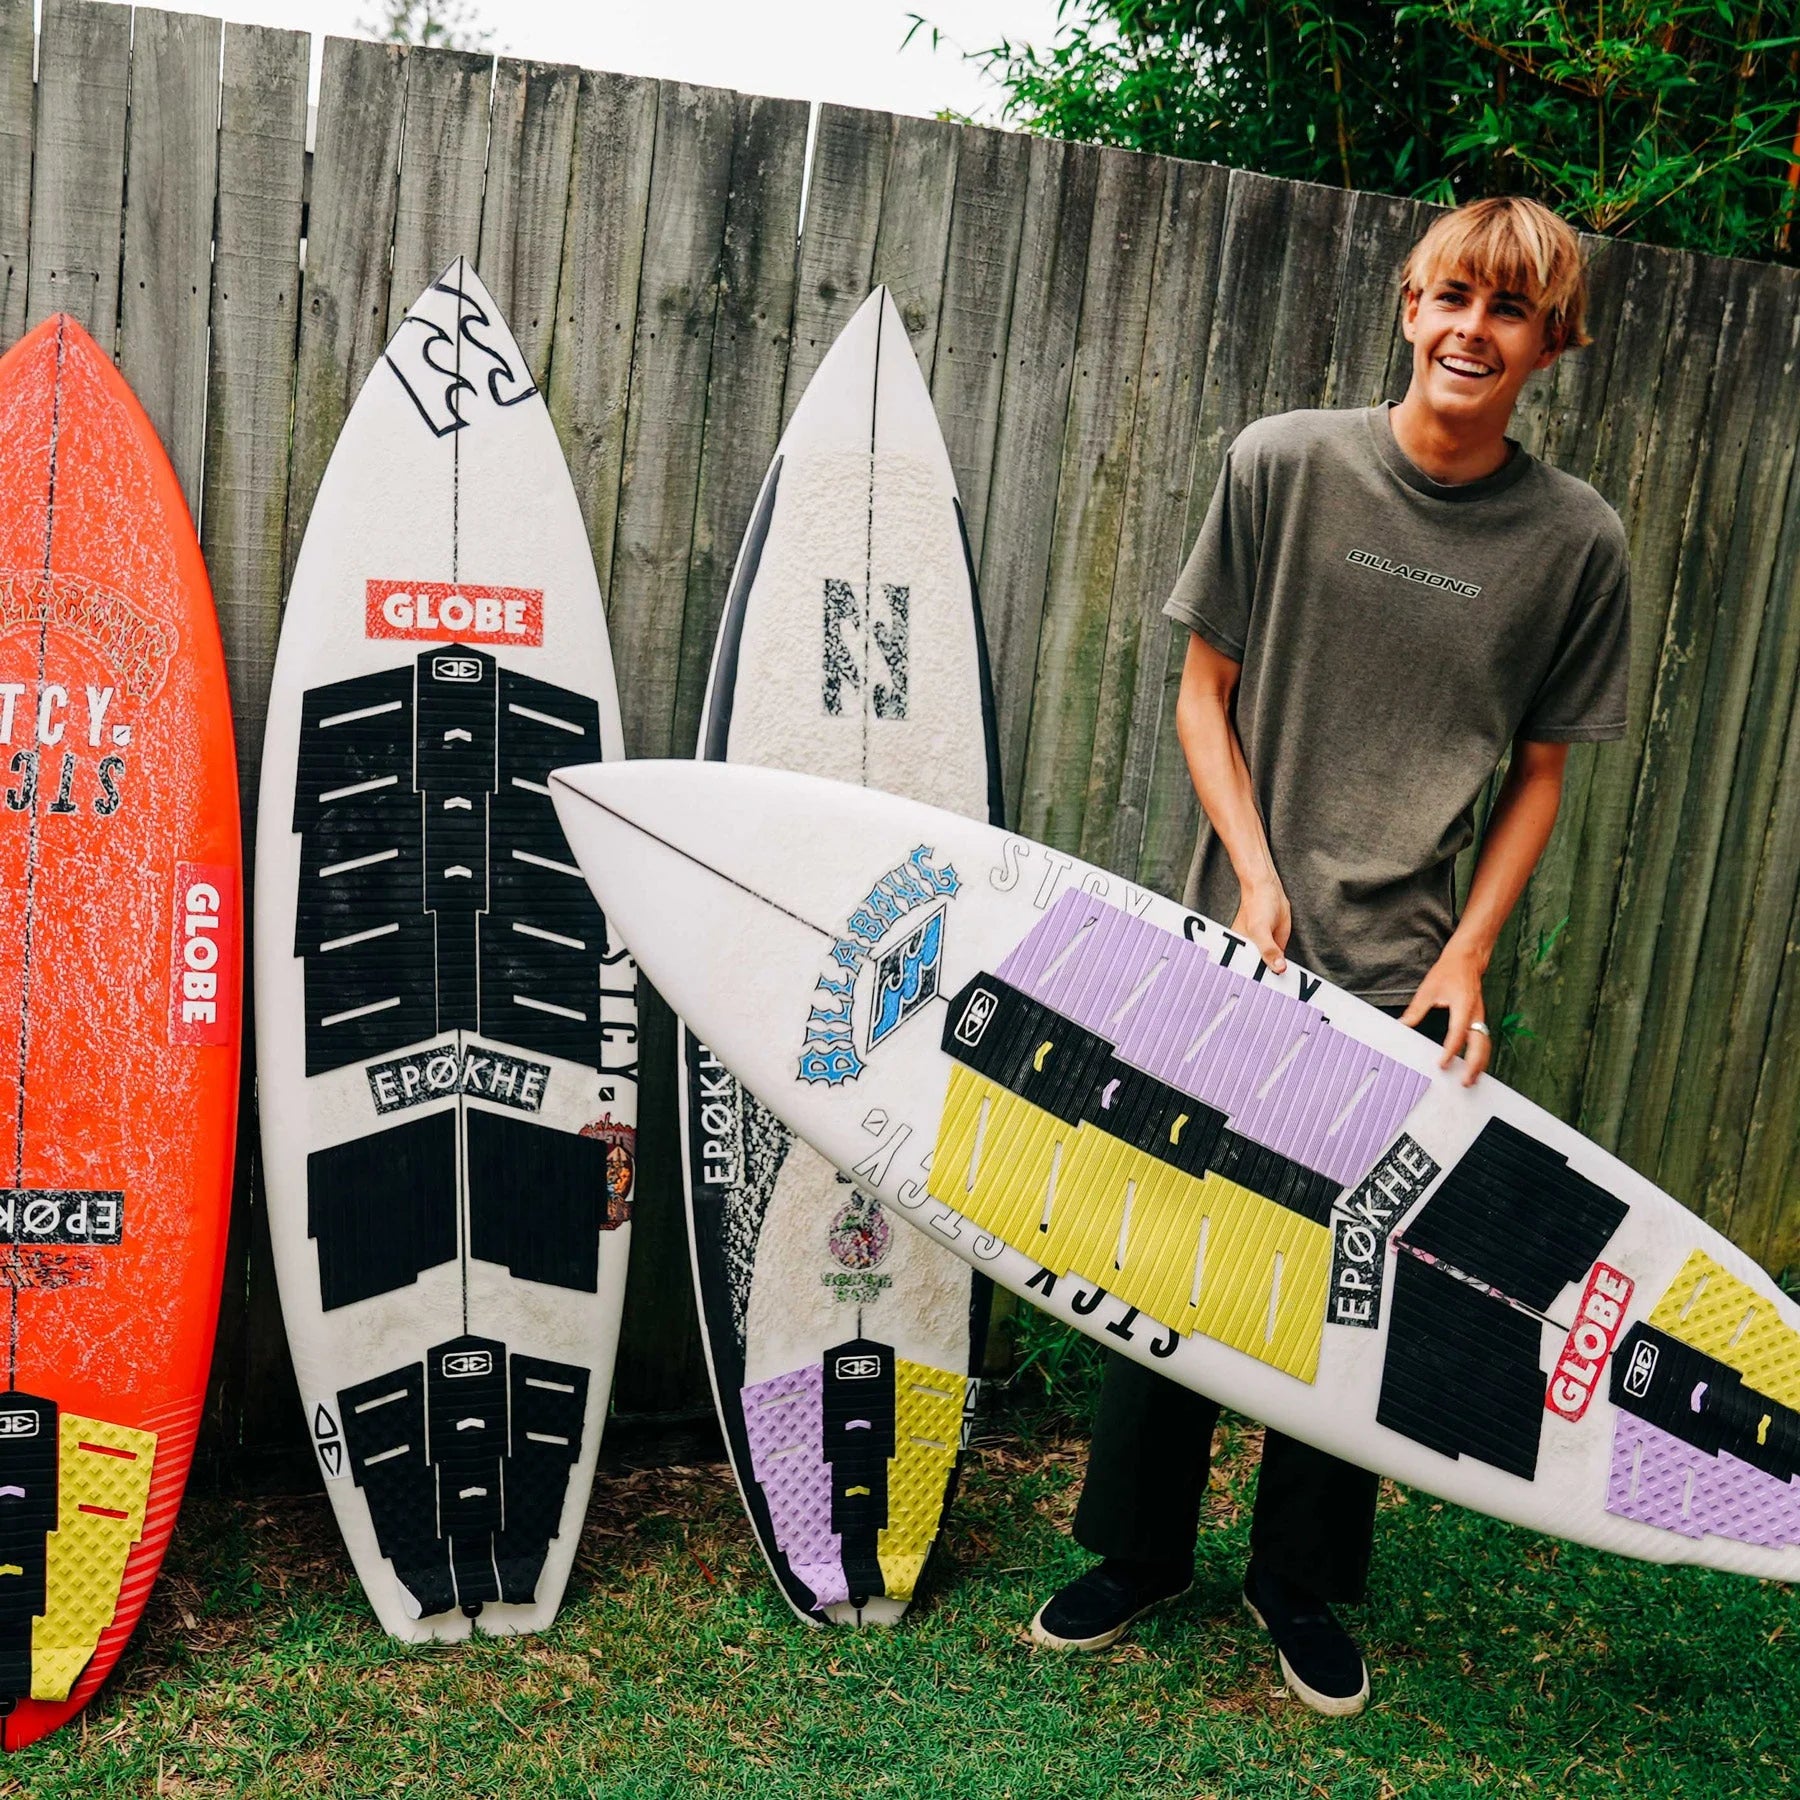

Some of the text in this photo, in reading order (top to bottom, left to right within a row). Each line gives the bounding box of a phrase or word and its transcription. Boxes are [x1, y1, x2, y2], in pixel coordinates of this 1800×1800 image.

[383, 594, 527, 635] GLOBE
[1346, 549, 1482, 599] BILLABONG
[182, 882, 220, 1025] GLOBE
[796, 844, 963, 1087] BILLABONG
[375, 1054, 543, 1105] EPØKHE
[1336, 1143, 1430, 1321] EPØKHE
[1551, 1269, 1630, 1412] GLOBE
